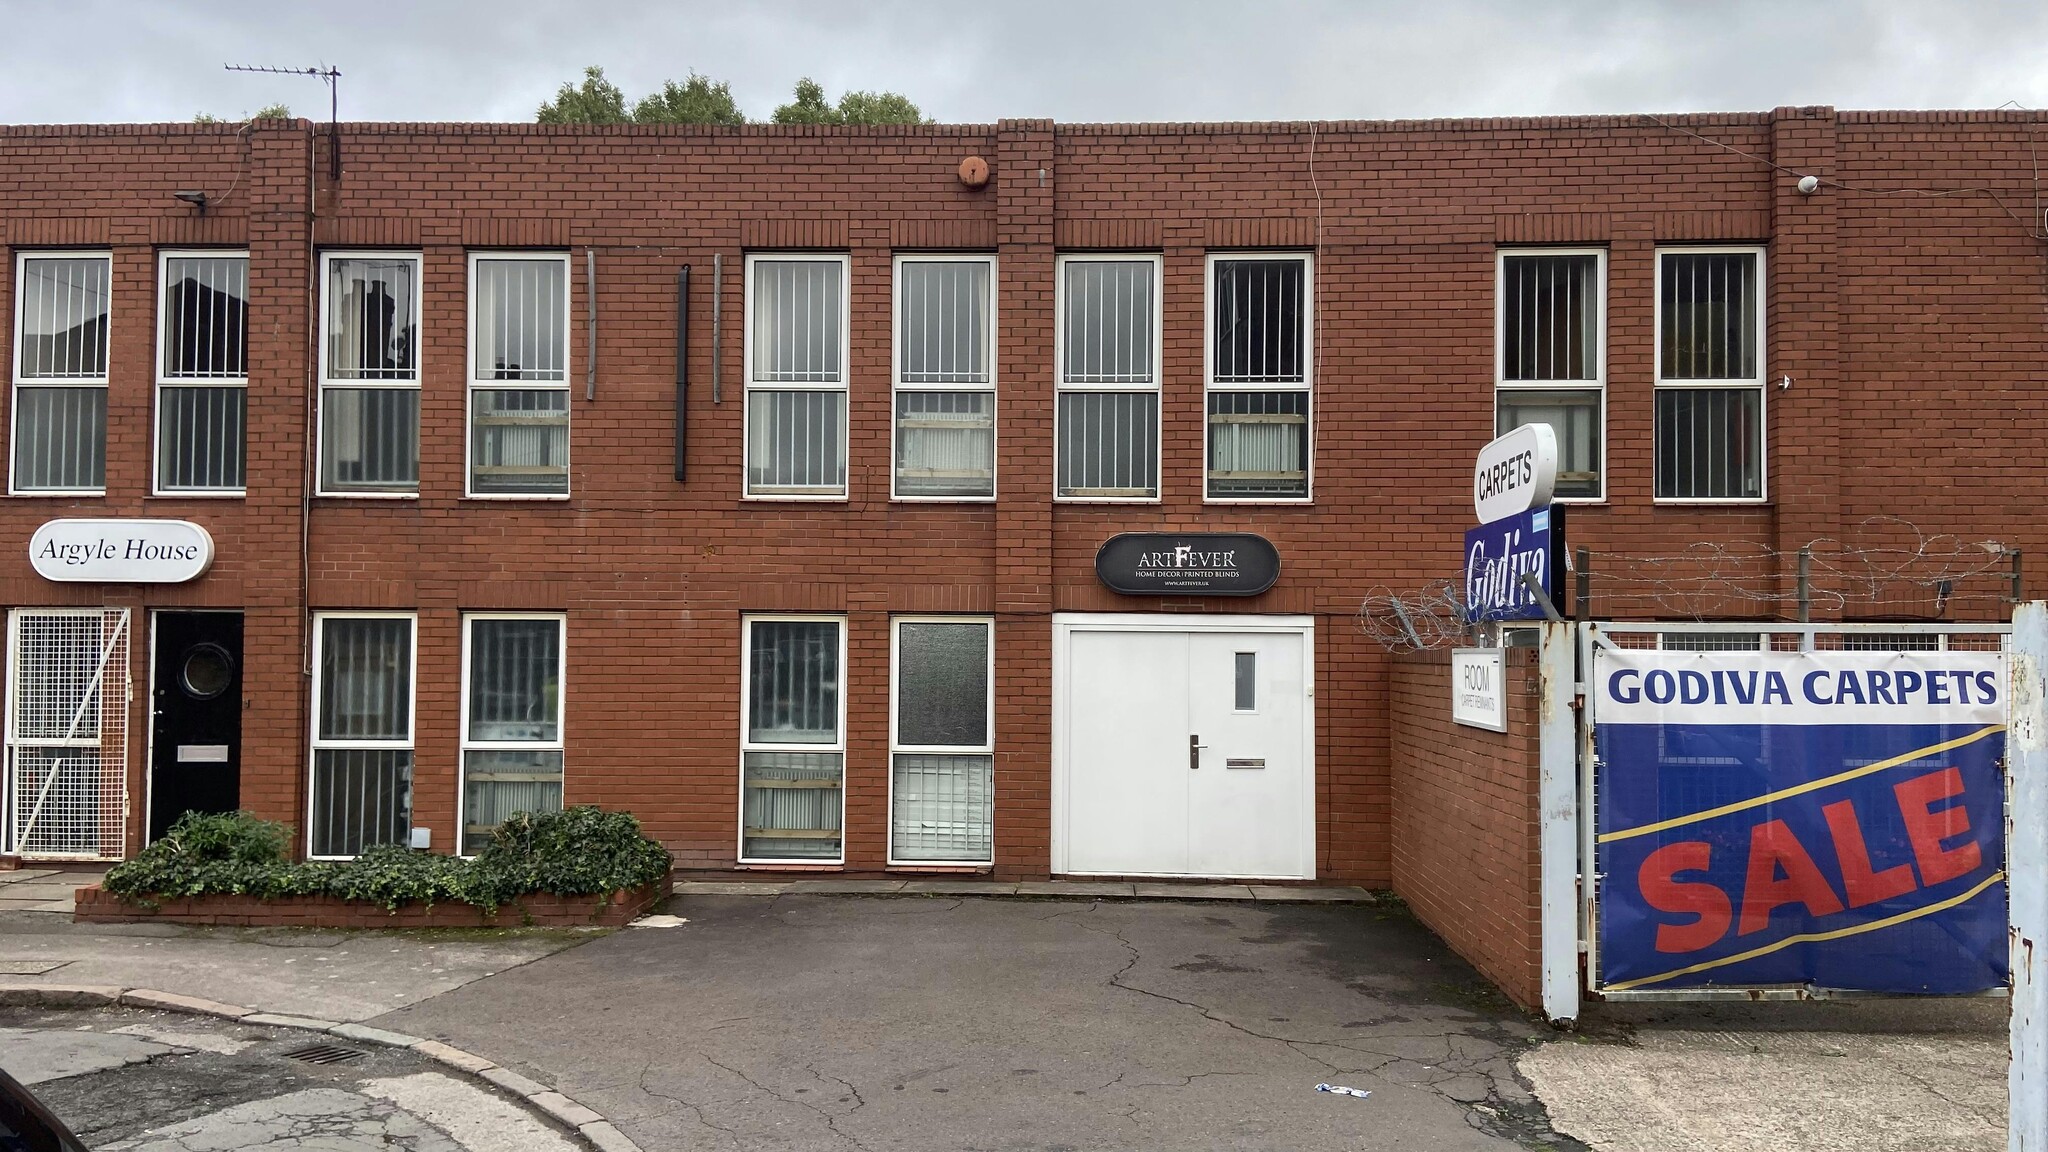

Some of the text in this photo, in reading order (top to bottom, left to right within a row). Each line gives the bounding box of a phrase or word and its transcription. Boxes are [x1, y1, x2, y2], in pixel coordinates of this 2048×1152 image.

[1478, 449, 1532, 501] CARPETS
[39, 539, 198, 565] Argyle House
[1466, 528, 1545, 611] Godiva
[1464, 664, 1490, 692] ROOM
[1608, 668, 1997, 705] GODIVA CARPETS
[1638, 767, 1982, 953] SALE
